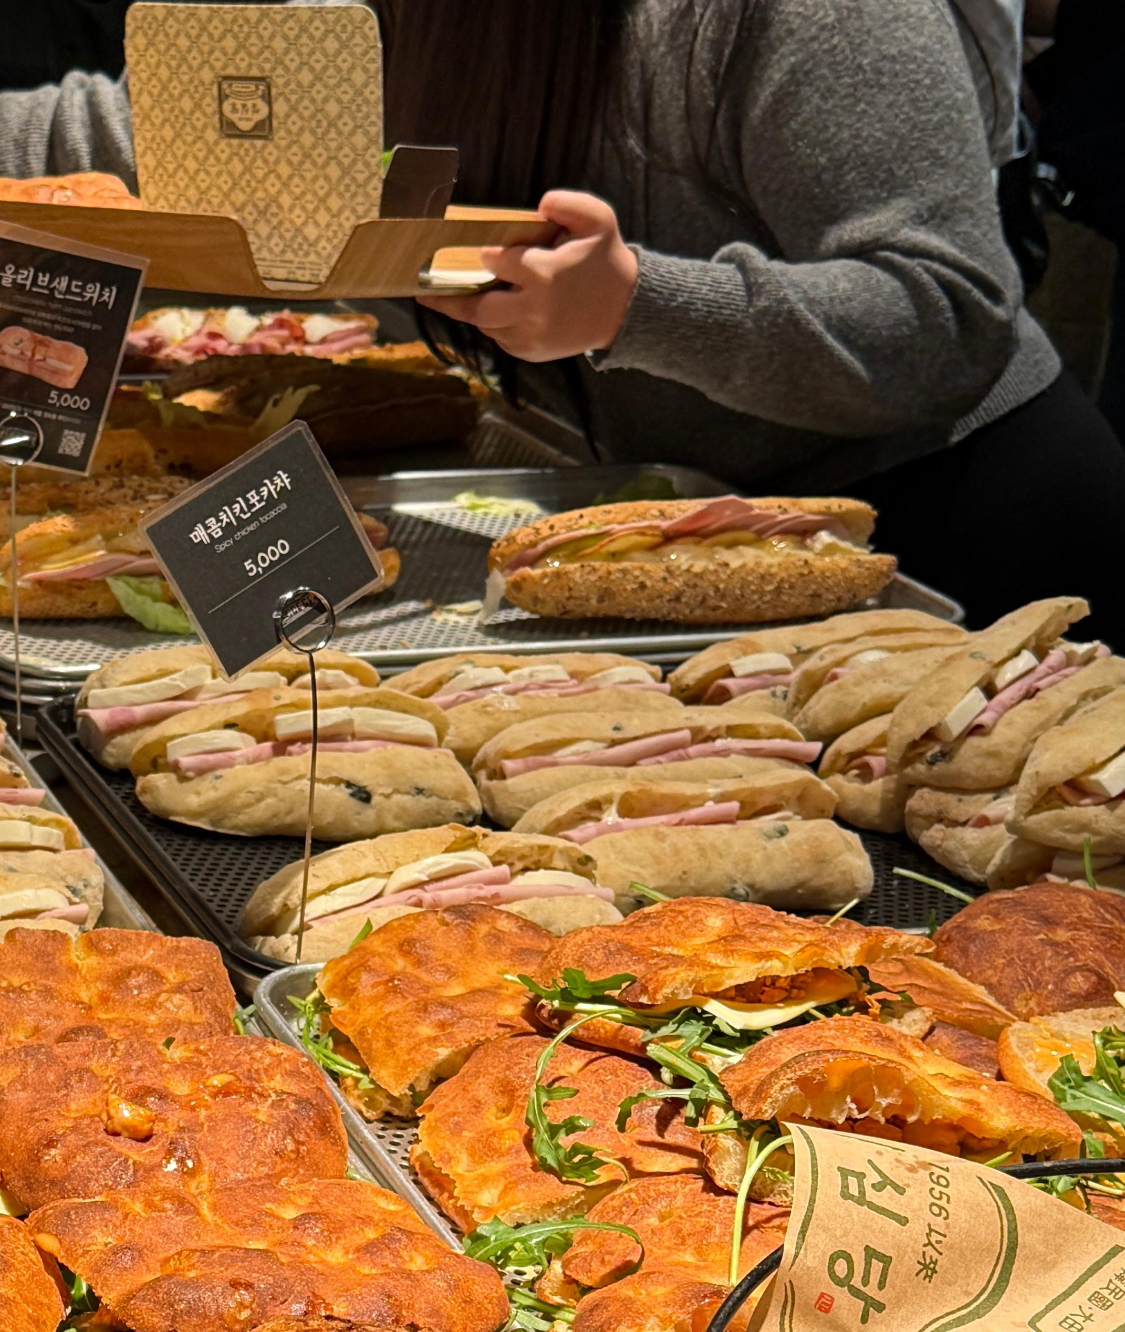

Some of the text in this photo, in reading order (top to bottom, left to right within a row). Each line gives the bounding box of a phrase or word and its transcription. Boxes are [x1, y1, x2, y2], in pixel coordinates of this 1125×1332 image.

[47, 389, 91, 411] 5,000
[234, 520, 260, 540] chicken
[244, 539, 291, 577] 5,000
[928, 1162, 952, 1222] 1956
